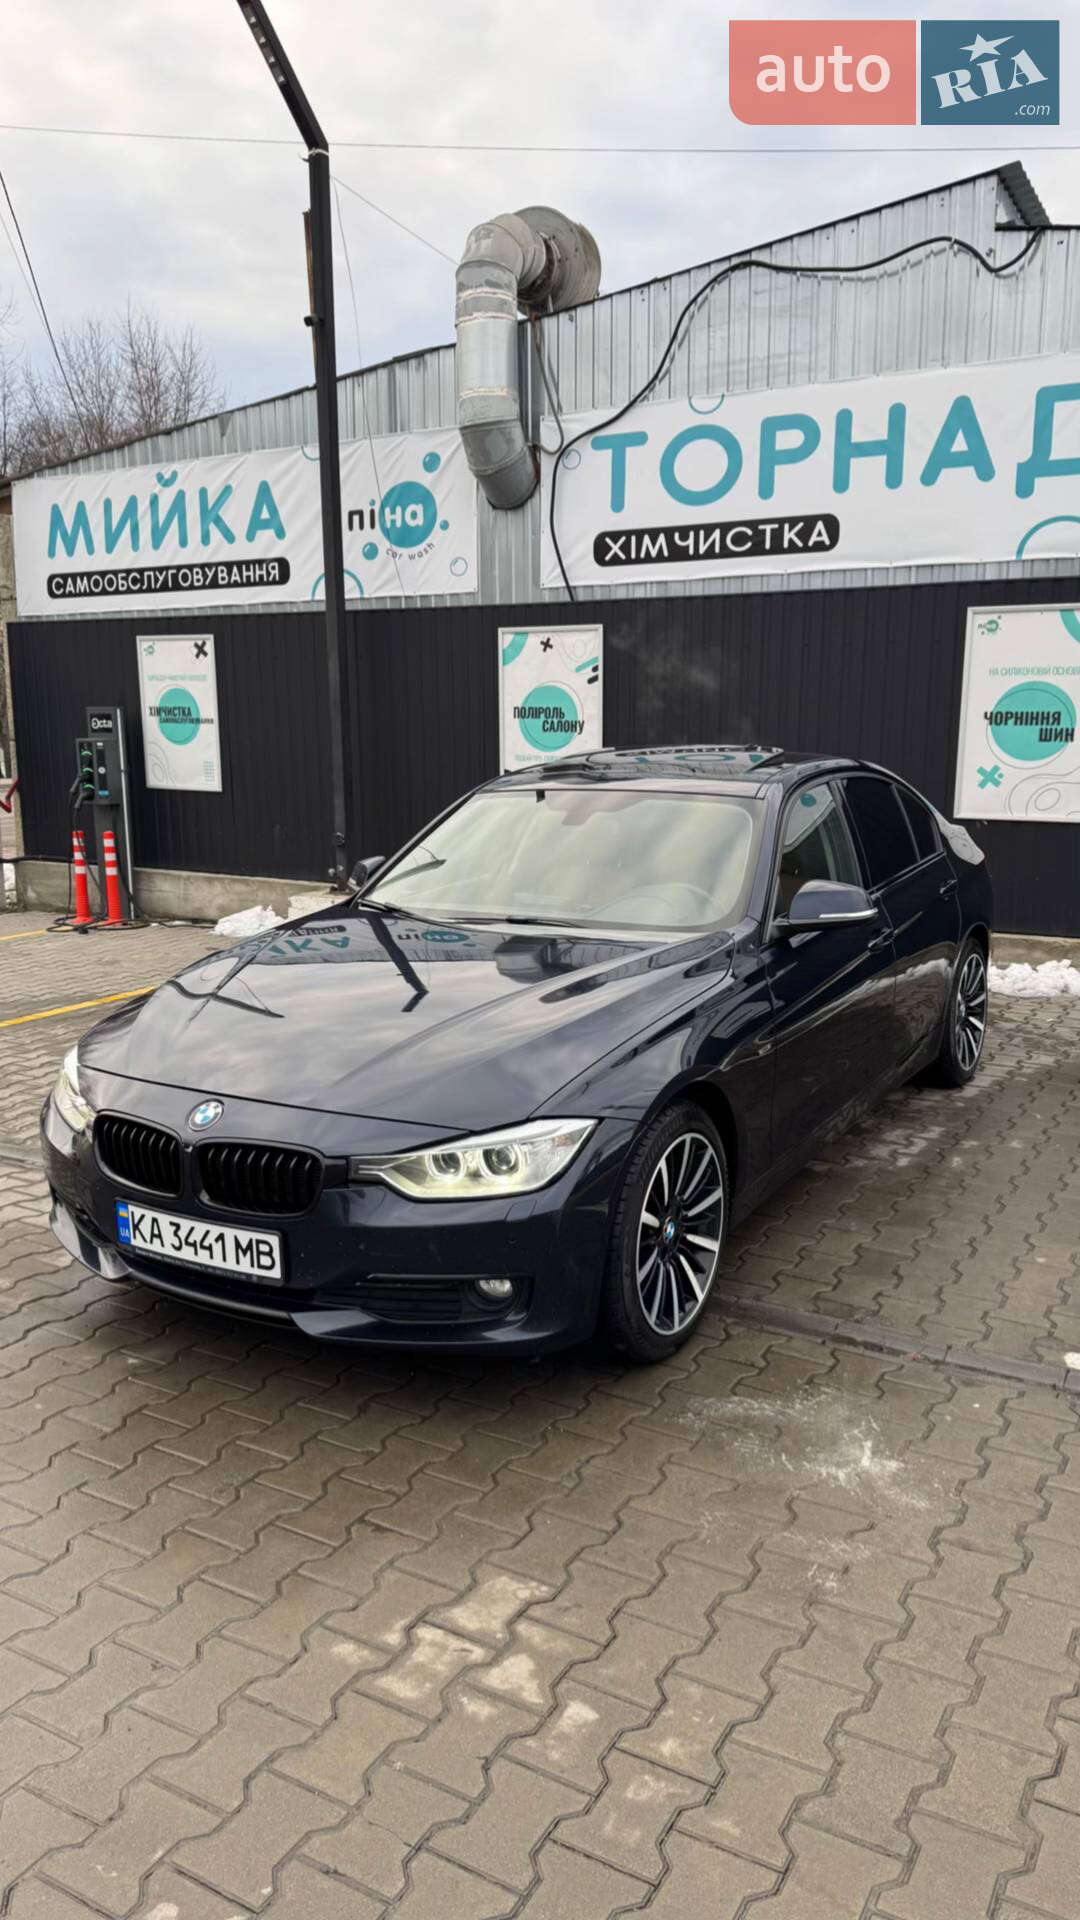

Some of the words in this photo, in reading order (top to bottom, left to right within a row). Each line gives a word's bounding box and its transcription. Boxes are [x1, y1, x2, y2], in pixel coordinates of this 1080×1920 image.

[47, 470, 286, 559] МИЙКА
[348, 499, 425, 531] піна
[386, 547, 403, 560] car
[408, 542, 436, 561] wash
[604, 519, 831, 562] ХІМЧИСТКА
[51, 561, 280, 595] САМООБСЛУГОВУВАННЯ
[513, 706, 566, 720] ПОЛІРОЛЬ
[983, 710, 1062, 727] ЧОРНІННЯ
[542, 719, 585, 736] САЛОНУ
[1038, 727, 1075, 743] ШИН
[131, 1210, 165, 1248] KA
[168, 1220, 228, 1263] 3441
[234, 1234, 276, 1271] MB
